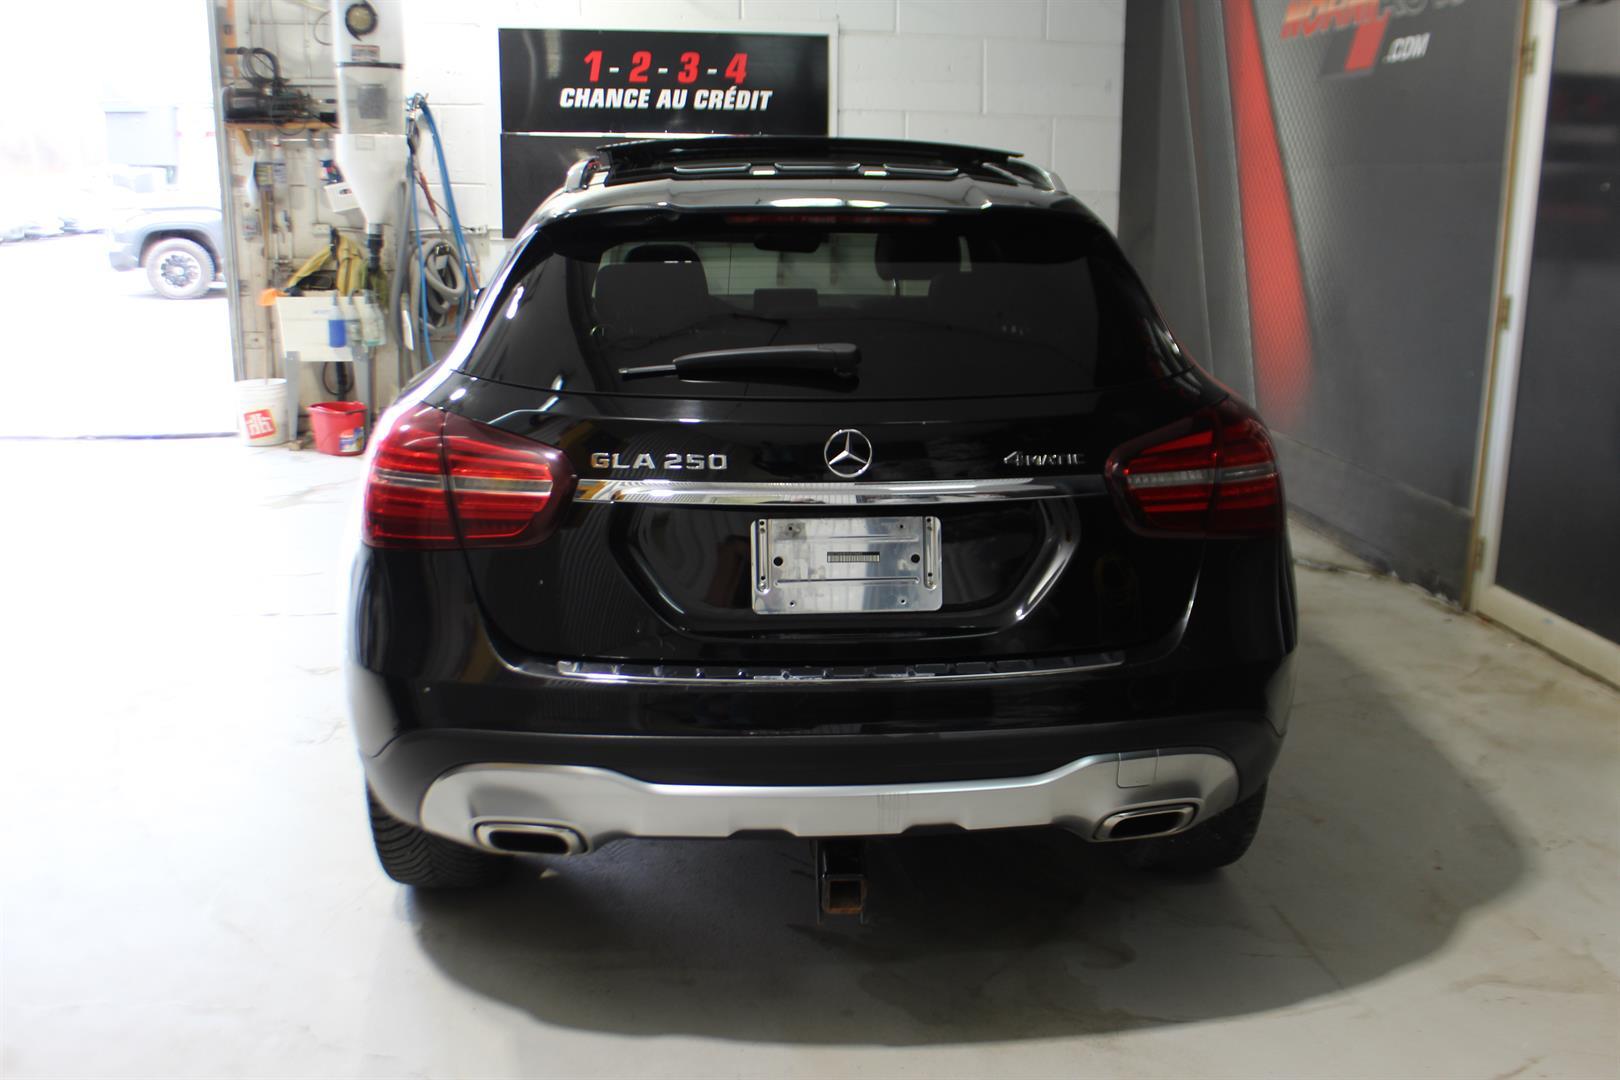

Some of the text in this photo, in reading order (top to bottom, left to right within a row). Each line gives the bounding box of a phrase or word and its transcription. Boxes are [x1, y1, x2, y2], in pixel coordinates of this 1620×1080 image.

[559, 86, 773, 111] CHANCE AU CRÉDIT
[591, 452, 728, 470] GLA 250
[1003, 451, 1084, 466] 4MATIC
